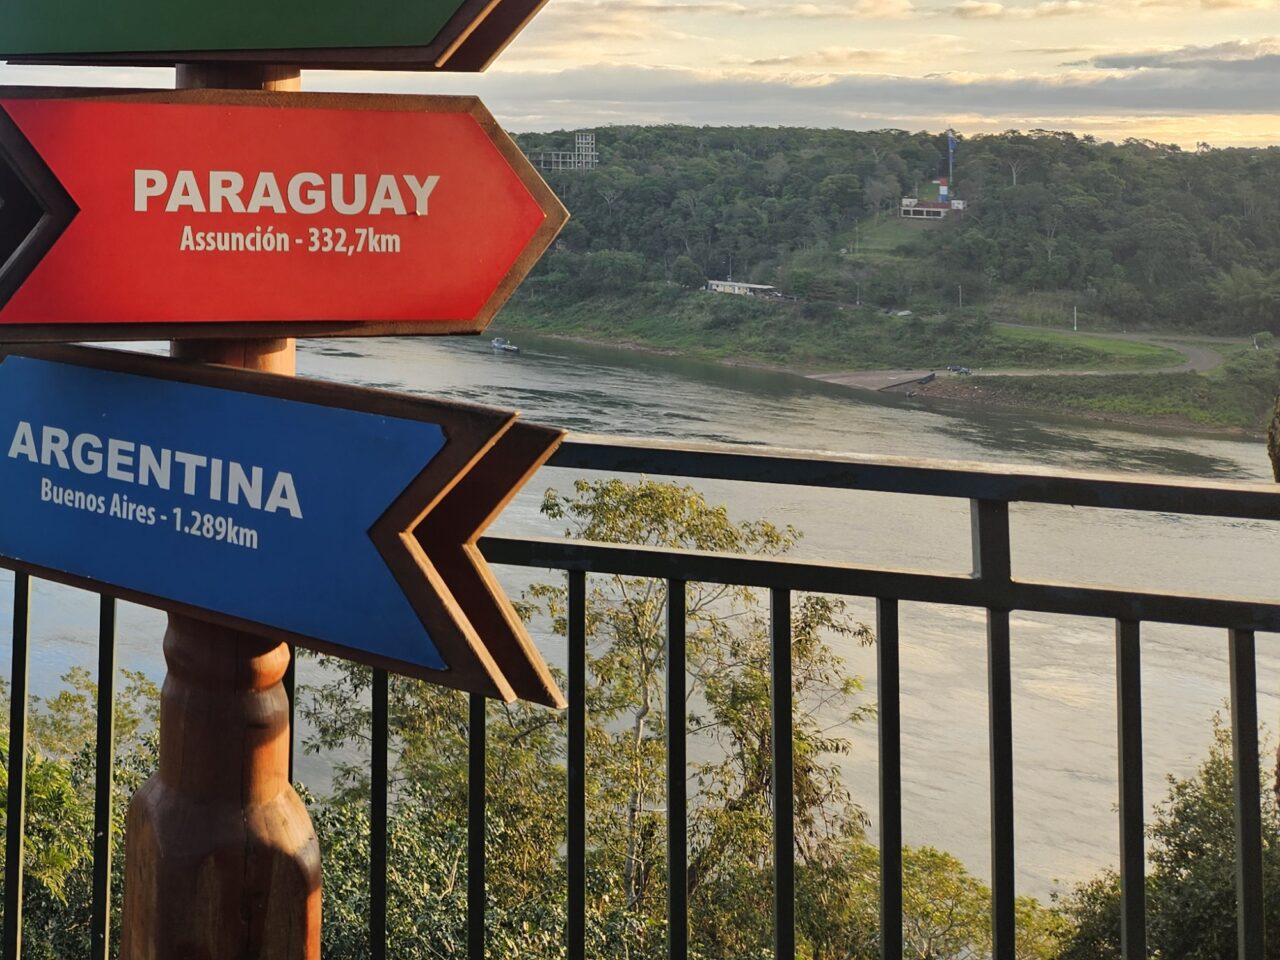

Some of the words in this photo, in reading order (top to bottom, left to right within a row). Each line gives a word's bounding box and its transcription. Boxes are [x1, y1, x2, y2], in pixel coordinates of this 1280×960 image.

[133, 169, 440, 216] PARAGUAY
[180, 225, 289, 252] Assunción
[308, 227, 400, 256] 332,7km
[8, 421, 303, 519] ARGENTINA
[41, 477, 105, 514] Buenos
[109, 493, 156, 525] Aires
[173, 507, 258, 549] 1.289km
